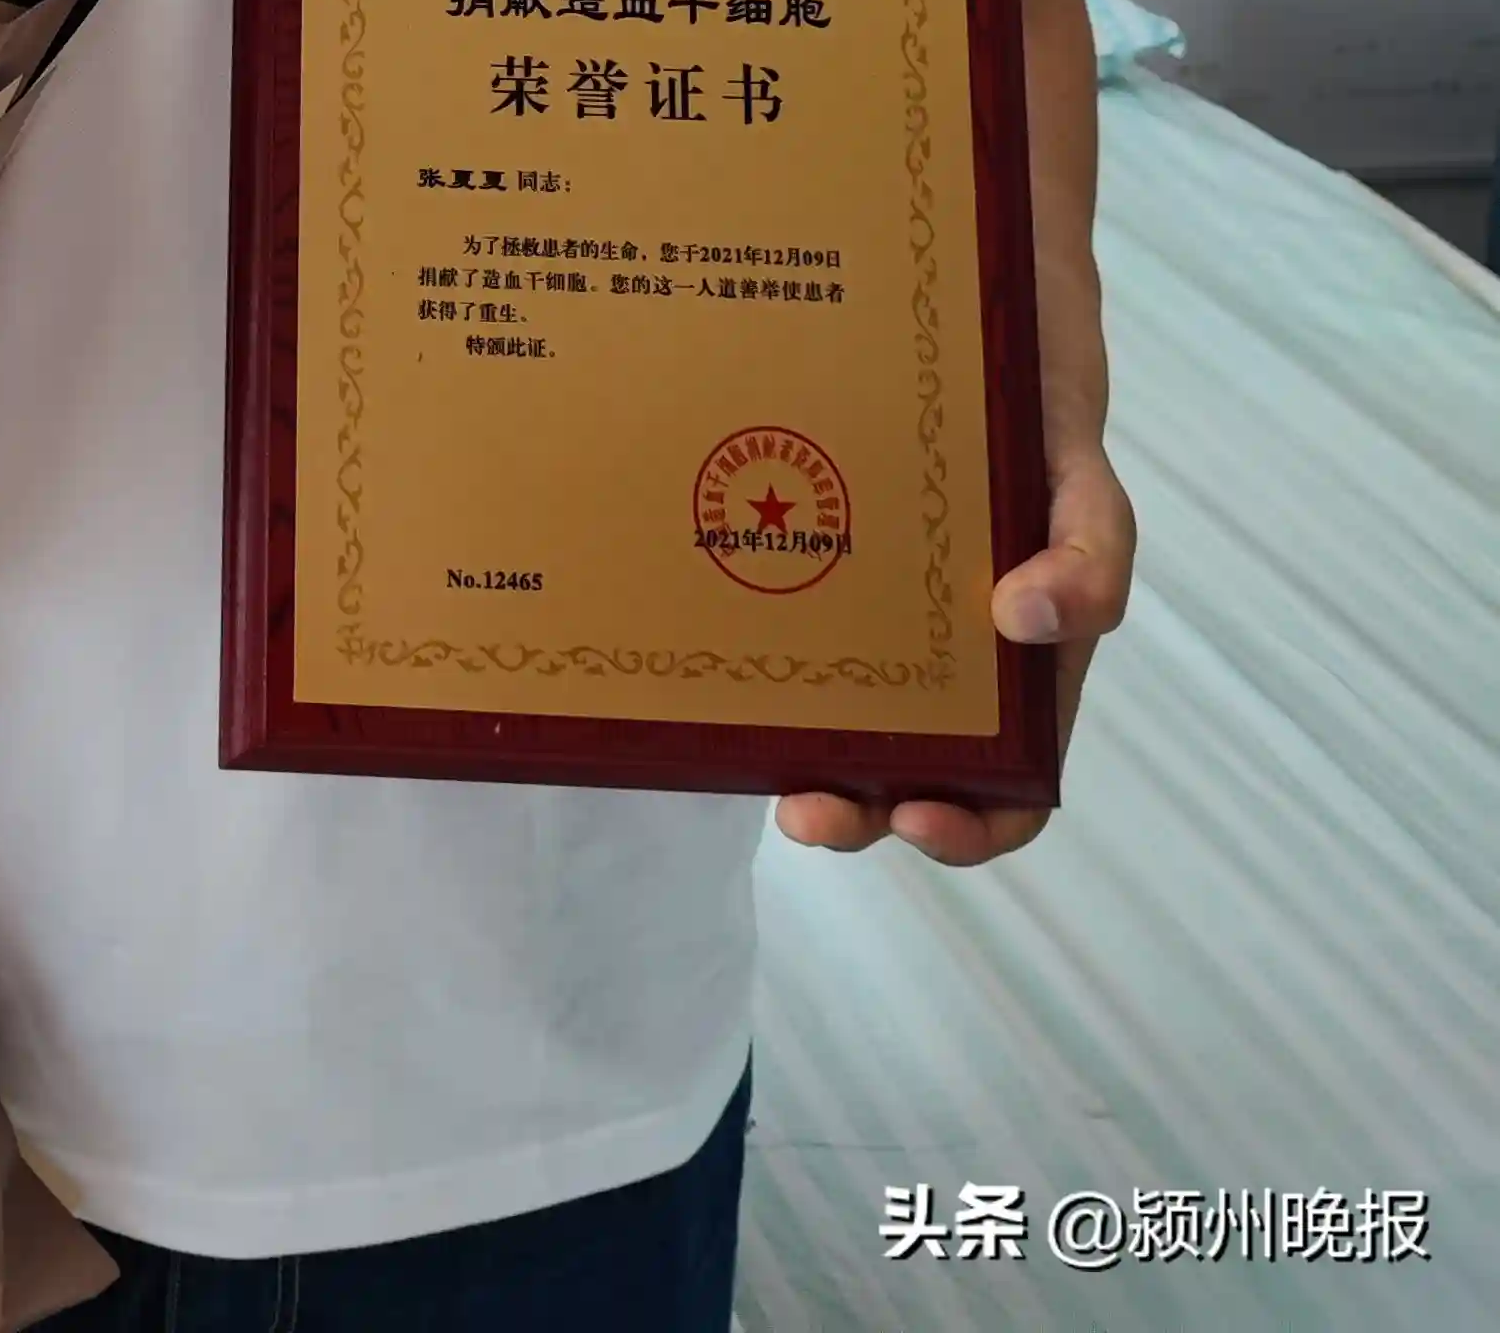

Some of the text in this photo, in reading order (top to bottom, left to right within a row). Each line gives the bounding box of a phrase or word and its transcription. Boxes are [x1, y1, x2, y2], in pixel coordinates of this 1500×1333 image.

[490, 55, 784, 125] 荣誉证书
[417, 300, 529, 325] 获得了重生。
[465, 335, 558, 359] 特颁此证。
[694, 528, 852, 554] 2021年12月09日
[446, 568, 543, 591] No.12465
